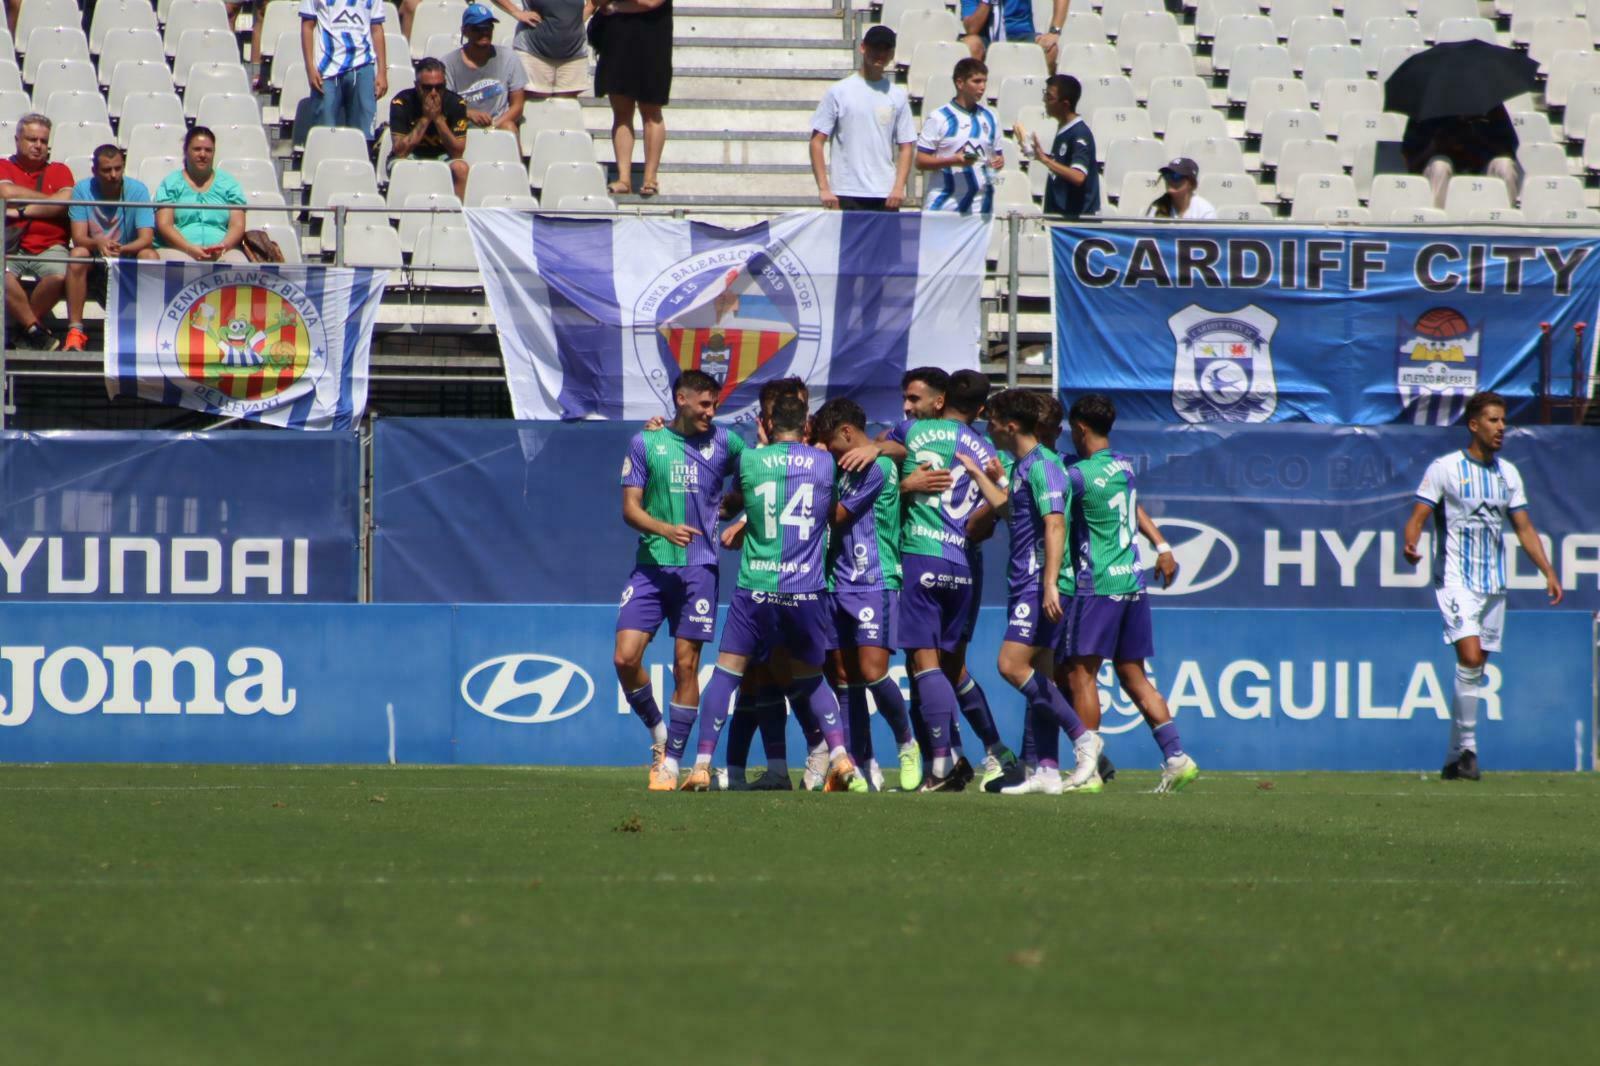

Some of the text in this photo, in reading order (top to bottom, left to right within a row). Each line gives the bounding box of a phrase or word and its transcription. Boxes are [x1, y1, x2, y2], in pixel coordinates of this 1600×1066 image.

[1289, 119, 1300, 128] 21
[642, 285, 669, 312] PENYA
[671, 249, 755, 282] BALEARIC
[762, 264, 785, 291] 2019
[1072, 237, 1592, 296] CARDIFF CITY
[168, 283, 210, 320] PENYA
[214, 271, 268, 286] BLANC
[280, 284, 319, 328] BLAVA
[762, 454, 814, 469] VICTOR
[908, 429, 956, 452] NELSON
[754, 481, 816, 541] 14
[0, 537, 309, 595] YUNDAI
[1263, 529, 1600, 590] HYUDA
